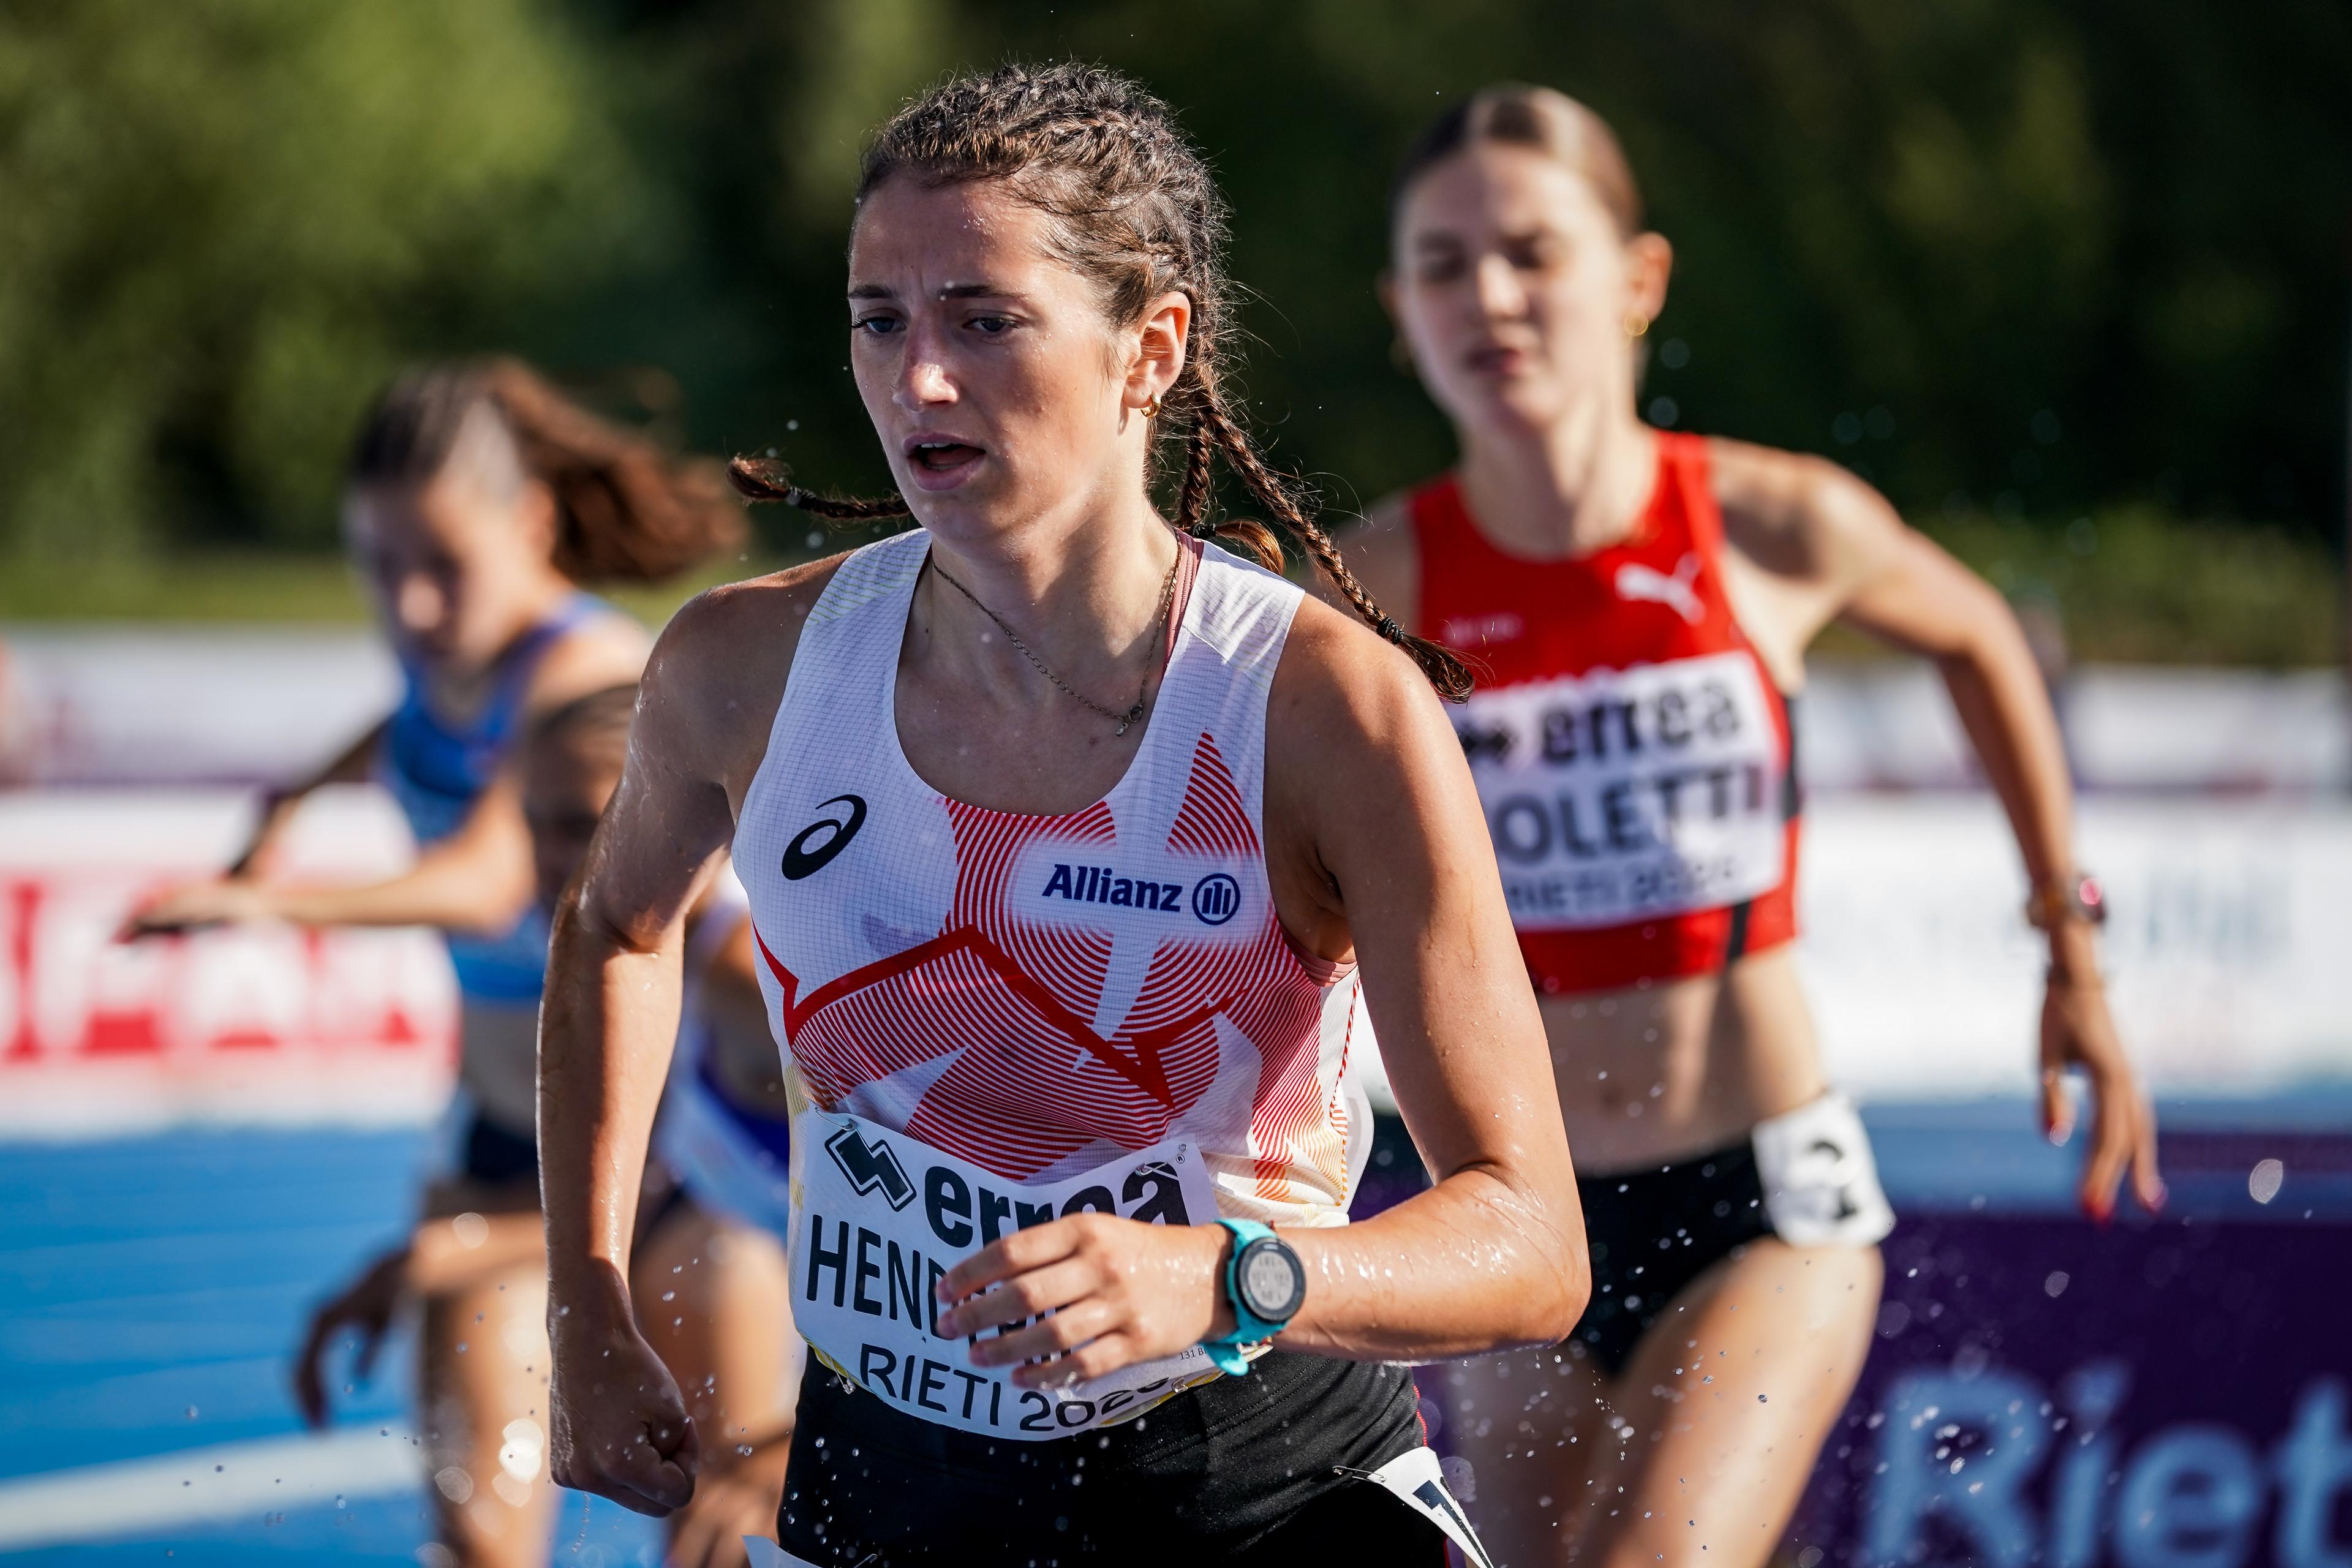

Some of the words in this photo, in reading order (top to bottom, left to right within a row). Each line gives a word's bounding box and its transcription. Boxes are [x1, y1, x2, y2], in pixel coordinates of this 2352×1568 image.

[1540, 678, 1741, 764] errea
[1493, 761, 1765, 862] OLETTI
[1042, 864, 1183, 912] Allianz
[860, 1343, 1001, 1426] RIETI
